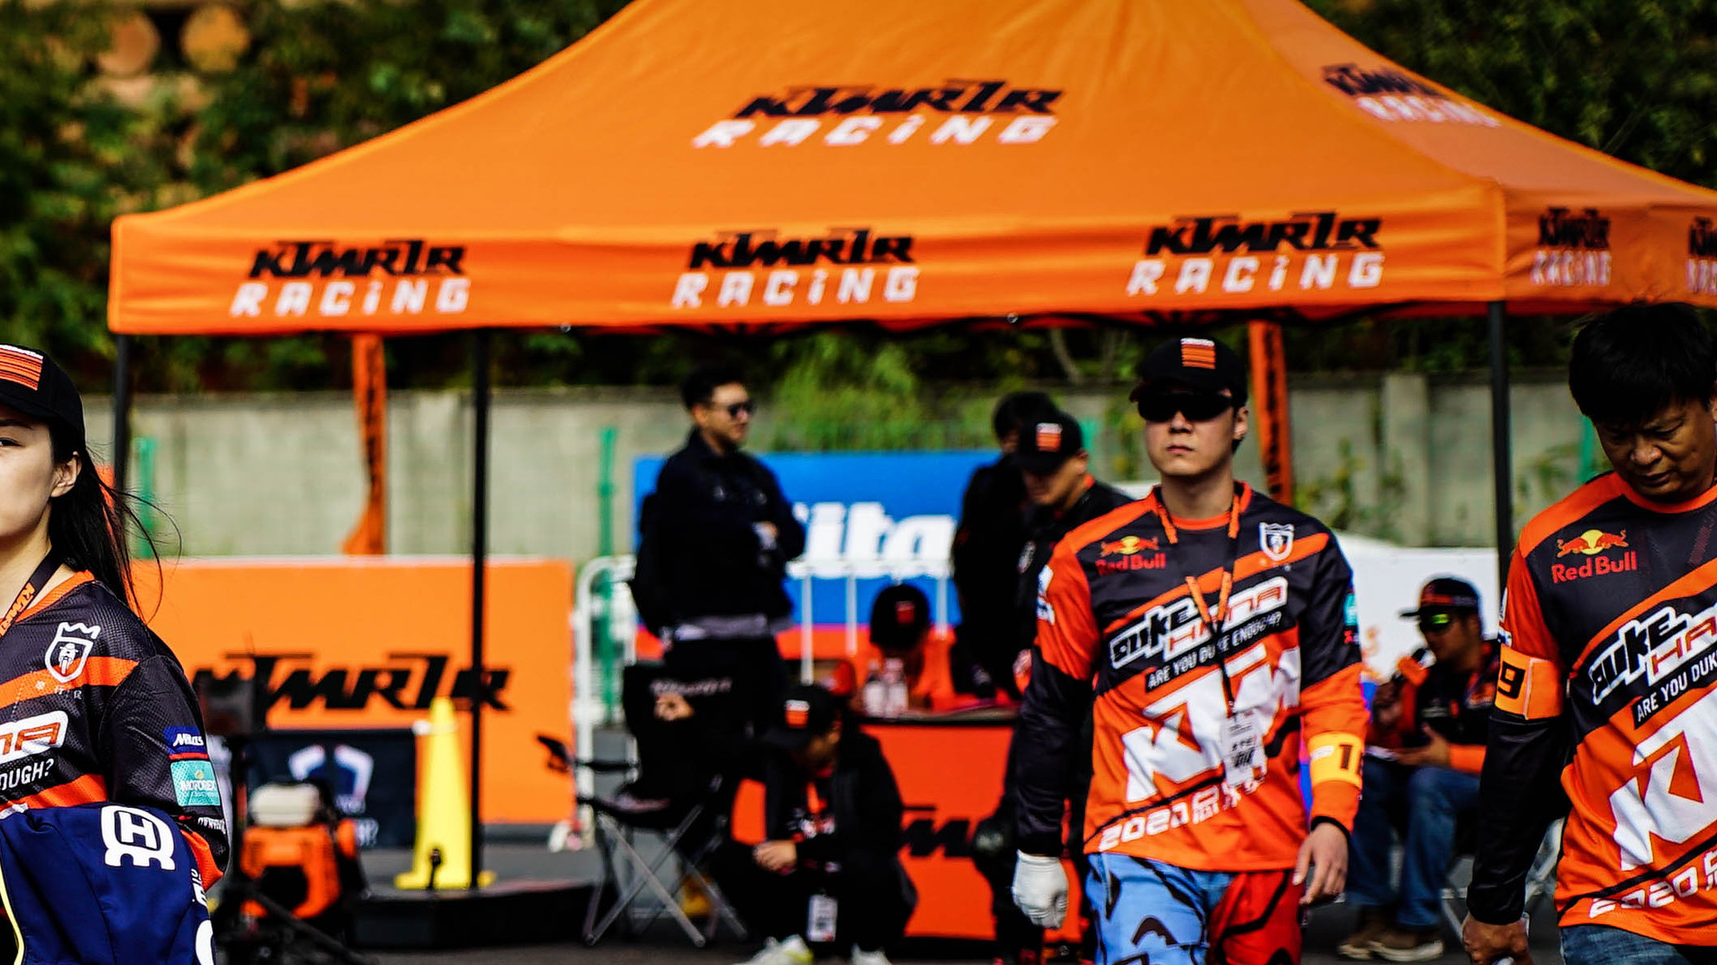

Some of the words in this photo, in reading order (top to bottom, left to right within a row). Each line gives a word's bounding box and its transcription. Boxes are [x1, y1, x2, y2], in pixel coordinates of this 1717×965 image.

[786, 502, 958, 578] ita
[1130, 552, 1167, 570] Bull
[1551, 559, 1593, 583] Red
[1595, 551, 1638, 576] Bull
[1147, 665, 1170, 689] ARE
[1173, 652, 1198, 677] YOU
[1637, 692, 1659, 721] ARE
[1660, 672, 1688, 706] YOU
[1122, 642, 1301, 803] KTM
